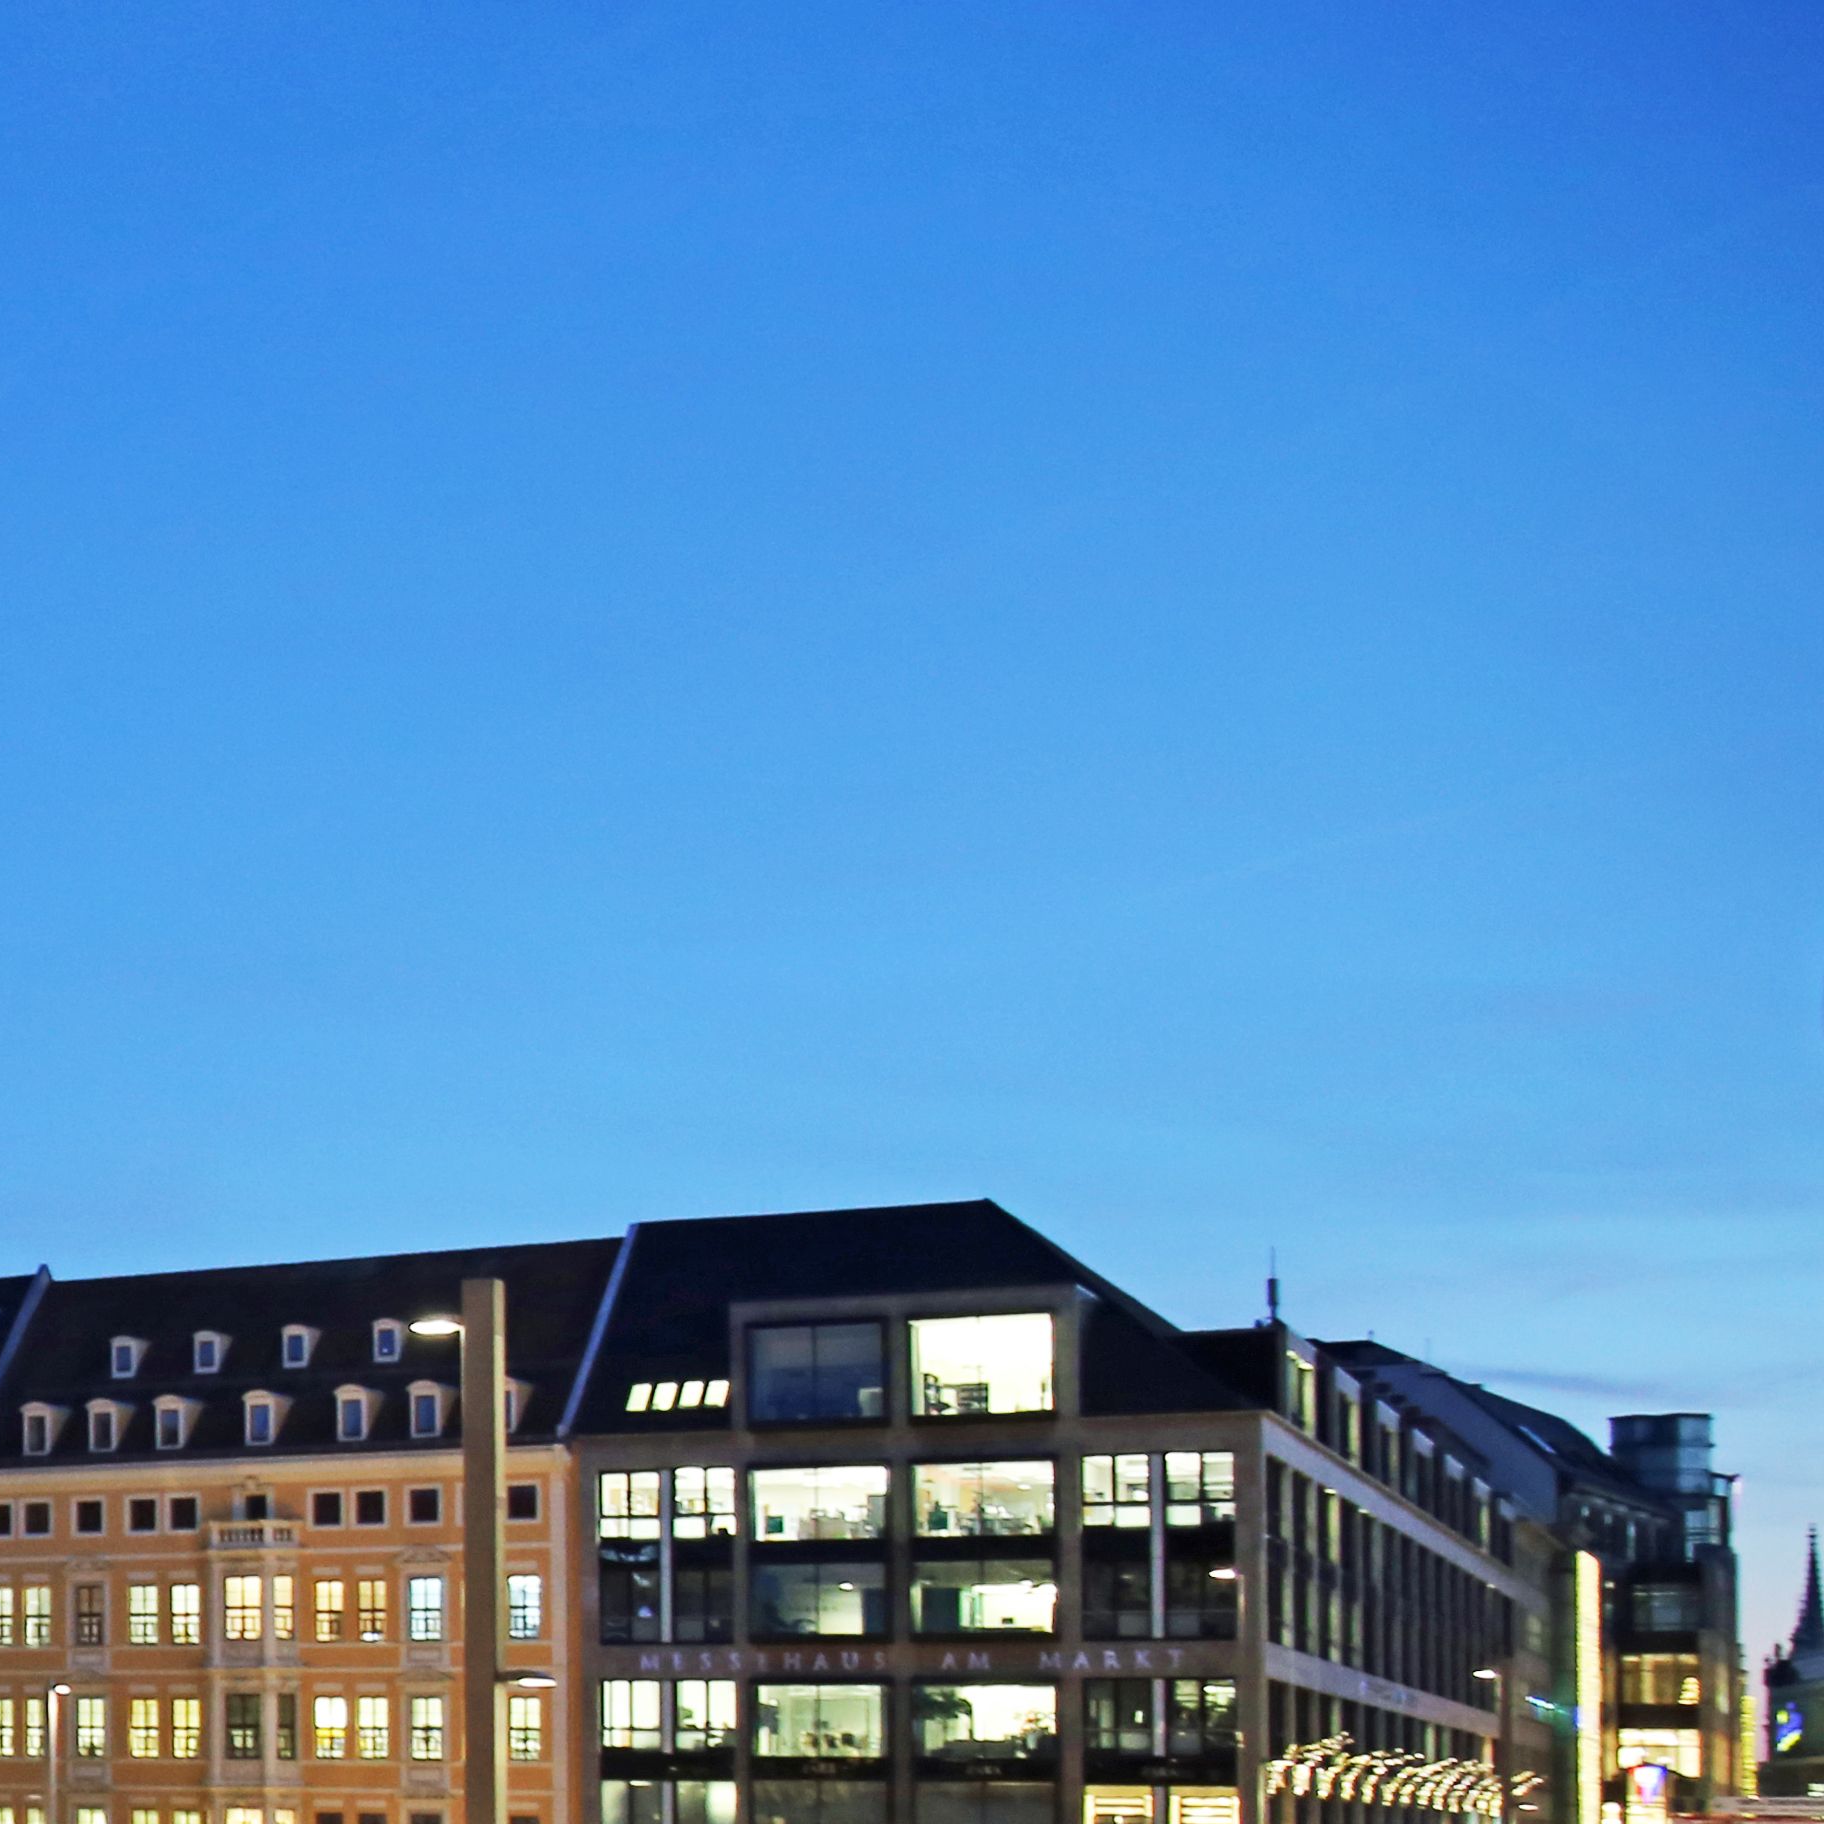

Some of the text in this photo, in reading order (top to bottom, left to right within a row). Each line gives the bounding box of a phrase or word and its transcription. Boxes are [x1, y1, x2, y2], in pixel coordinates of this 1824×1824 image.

[639, 1649, 1184, 1672] MESSEHAUS AM MARKT
